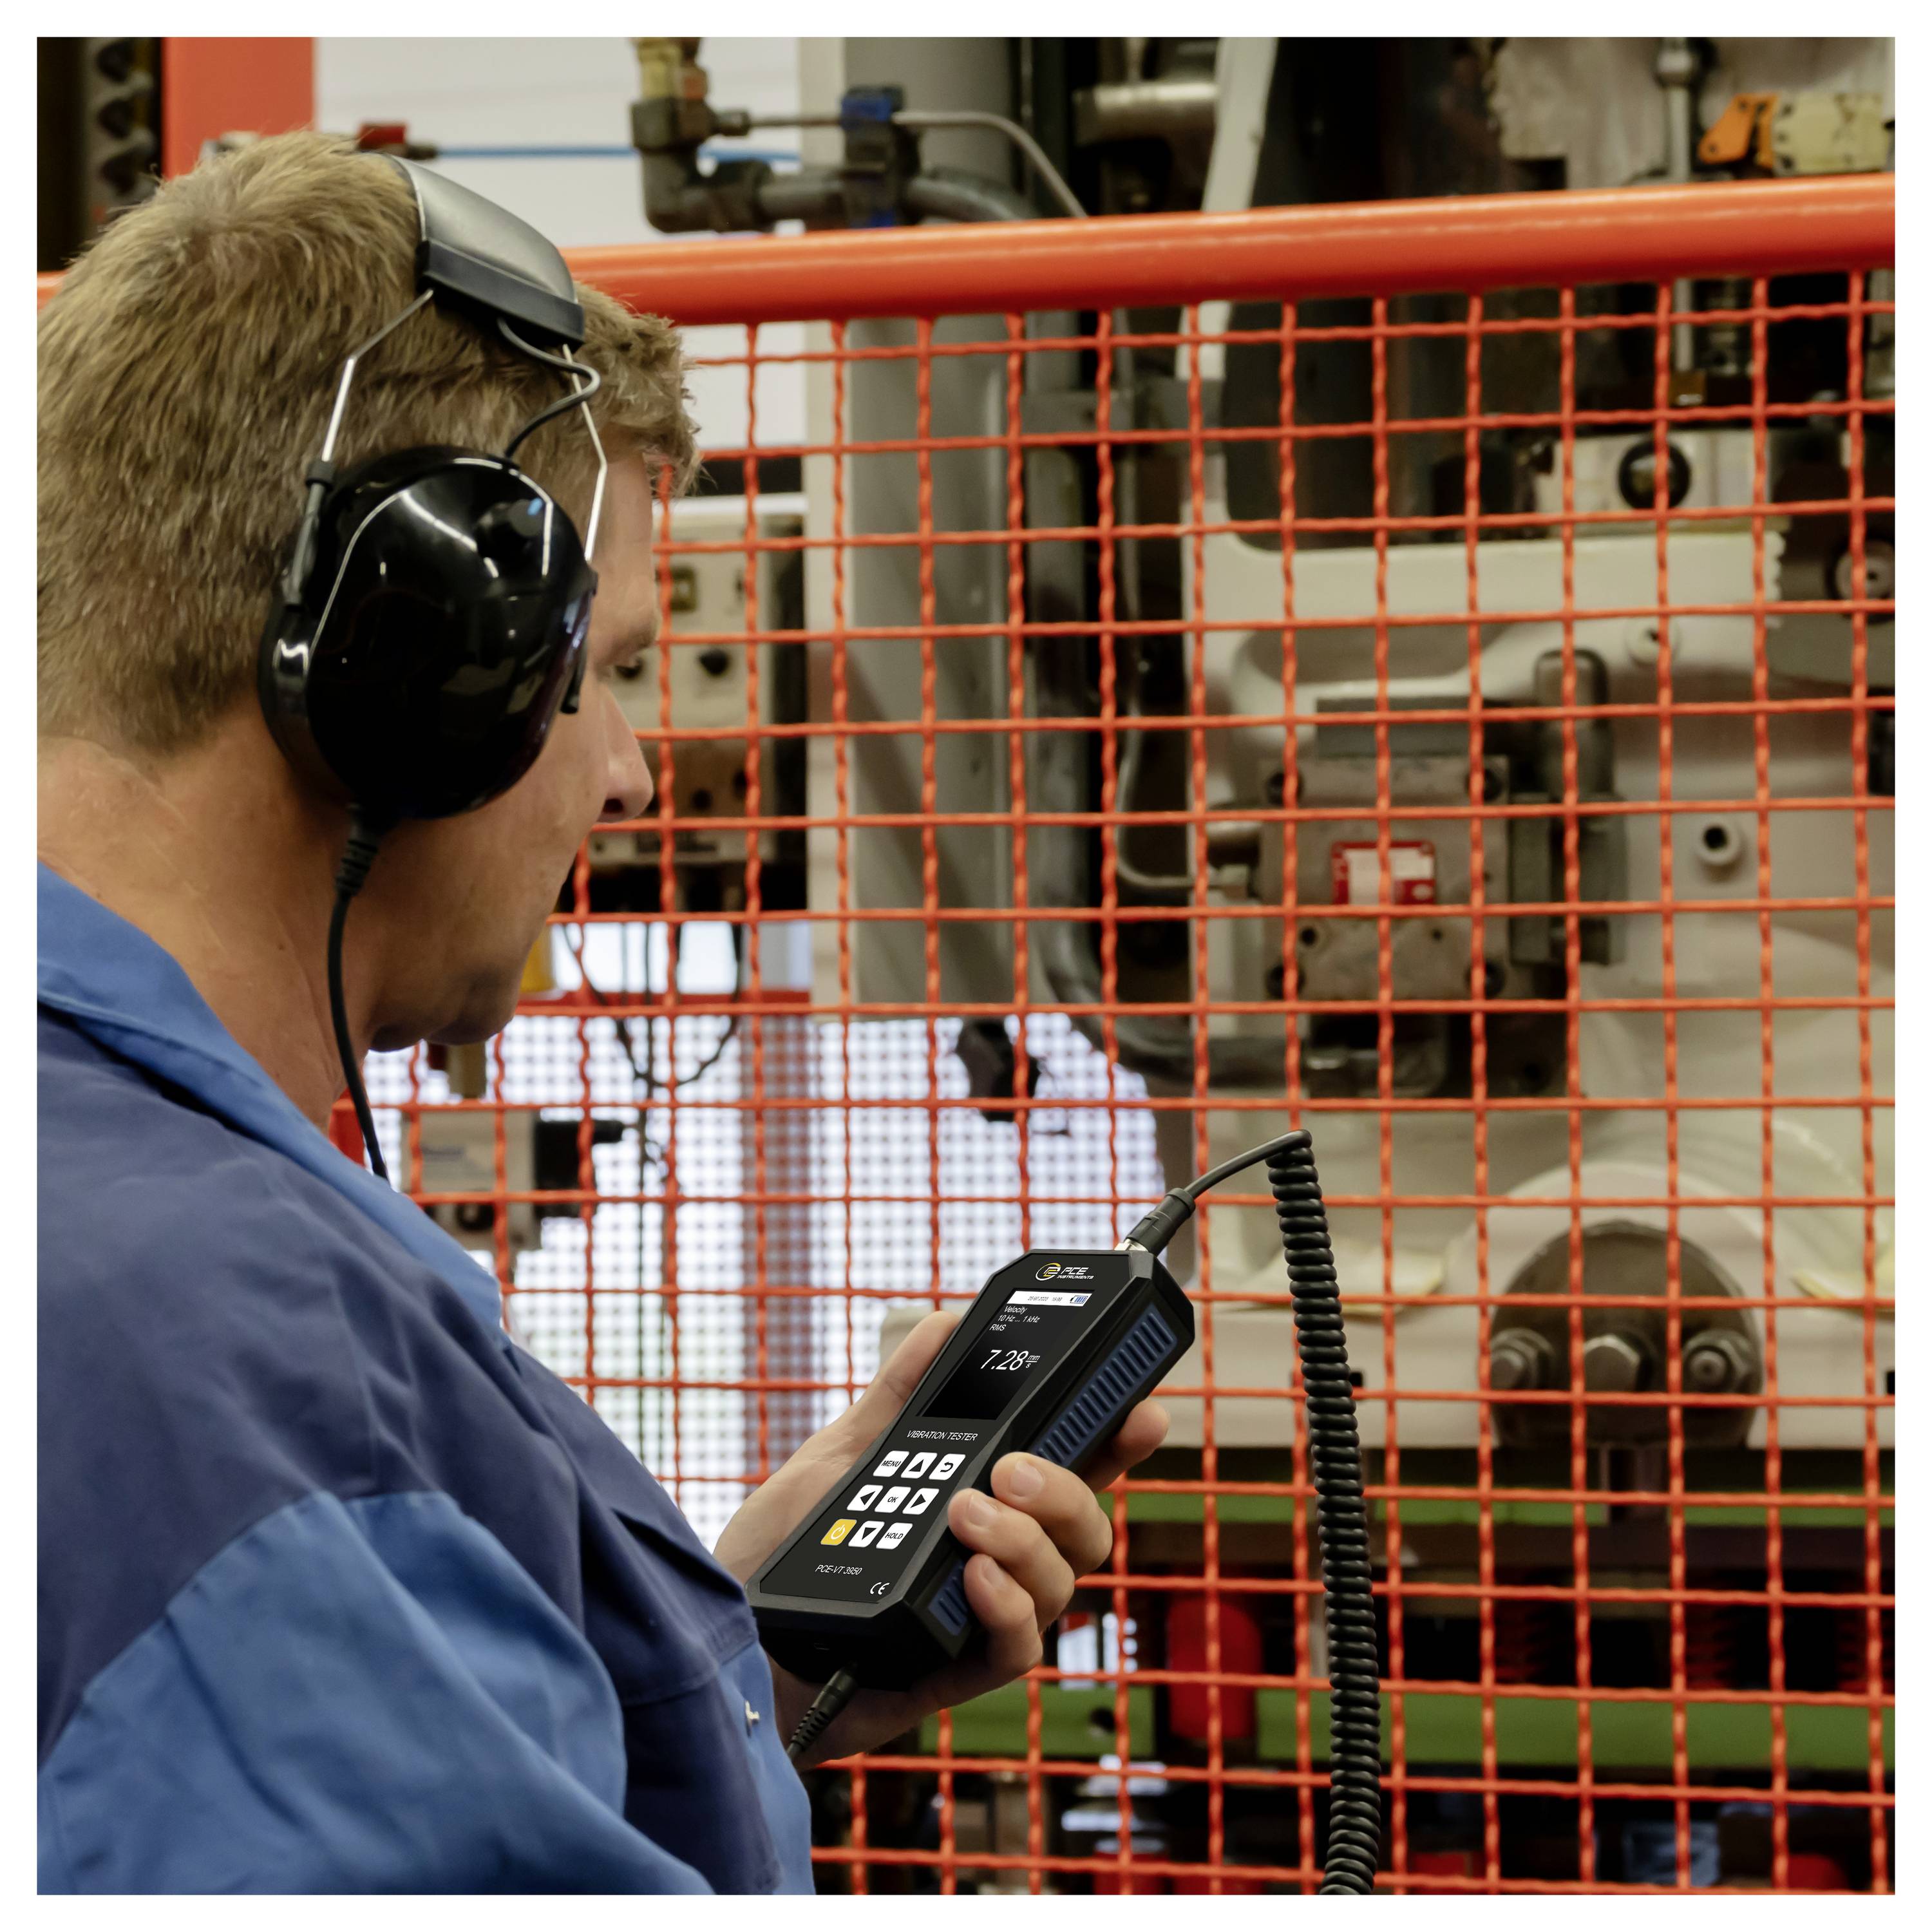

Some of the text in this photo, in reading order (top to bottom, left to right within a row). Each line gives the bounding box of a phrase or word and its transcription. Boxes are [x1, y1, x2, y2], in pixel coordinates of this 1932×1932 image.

[1004, 1305, 1028, 1315] Velocity
[980, 1349, 1029, 1371] 7.28
[907, 1430, 978, 1441] VIBRATION TESTER
[815, 1564, 863, 1575] PCE-VT 3950
[869, 1582, 890, 1595] CE
